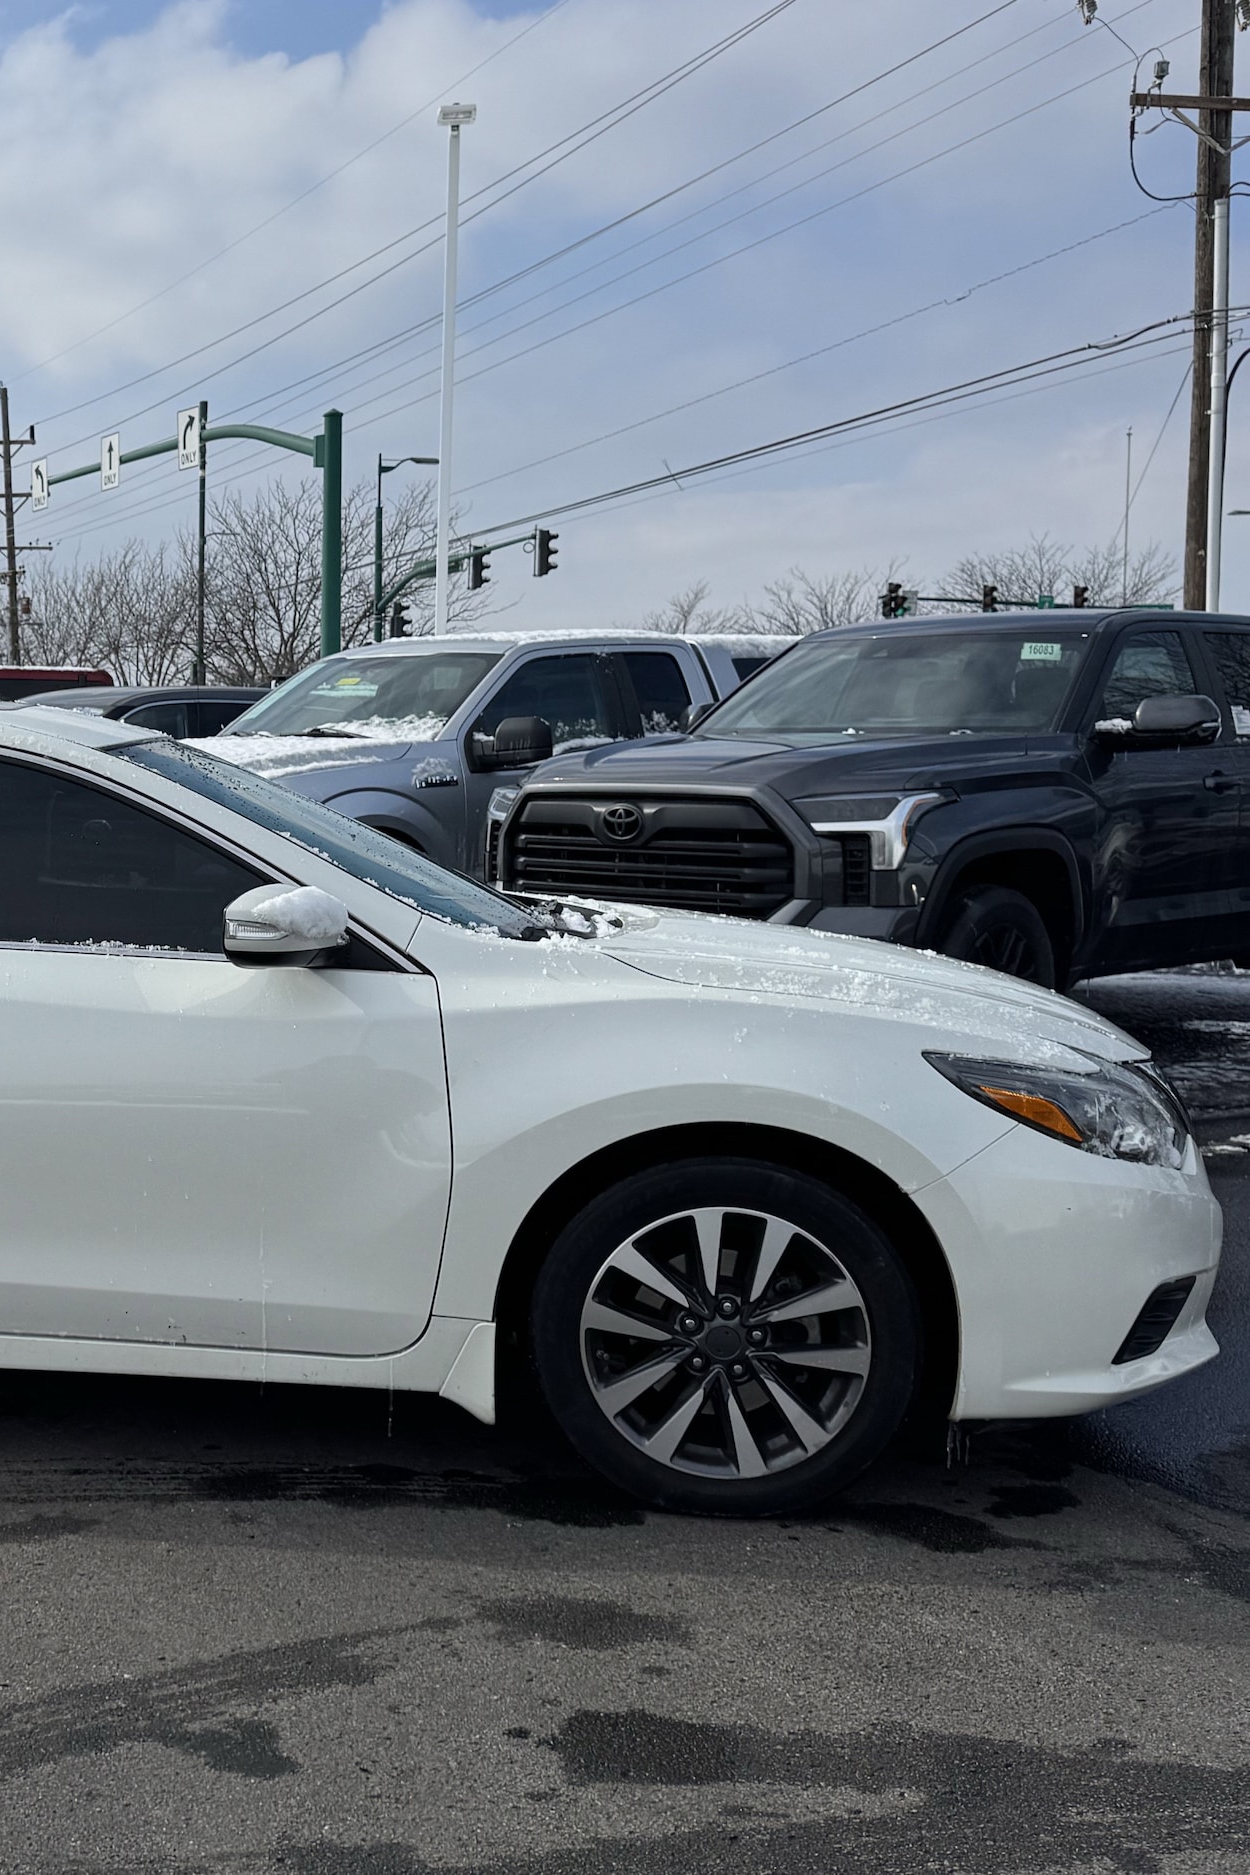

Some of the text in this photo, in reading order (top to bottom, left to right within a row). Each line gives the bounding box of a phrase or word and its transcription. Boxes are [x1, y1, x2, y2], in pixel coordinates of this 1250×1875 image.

[181, 450, 196, 465] ONLY
[104, 473, 117, 486] ONLY
[34, 495, 46, 507] ONLY
[1028, 644, 1054, 655] 16083
